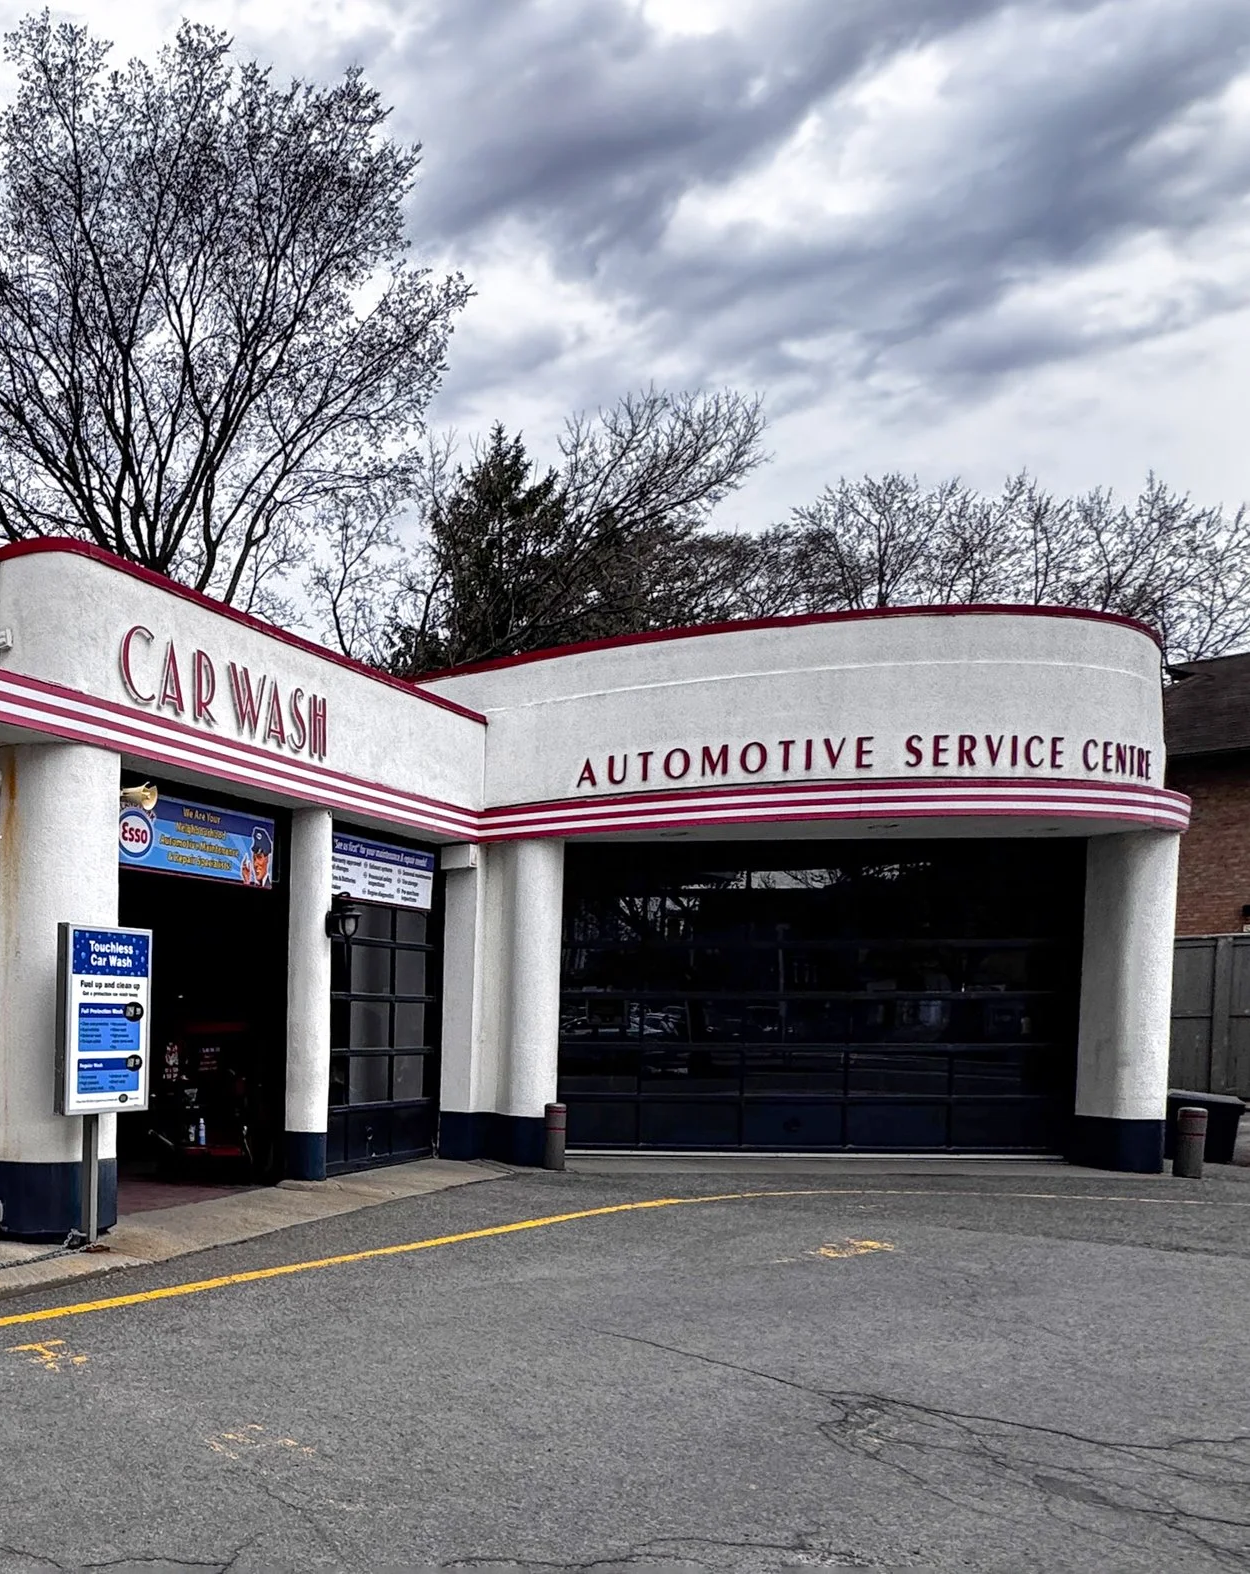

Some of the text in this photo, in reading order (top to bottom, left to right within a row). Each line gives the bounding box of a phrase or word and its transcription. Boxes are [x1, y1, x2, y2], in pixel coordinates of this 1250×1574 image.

[120, 625, 327, 761] CAR WASH
[576, 734, 1153, 788] AUTOMOTIVE SERVICE CENTRE
[182, 806, 221, 825] We Are Your
[121, 821, 148, 844] Esso
[89, 940, 134, 955] Touchless
[90, 953, 133, 968] Car Wash
[80, 980, 94, 988] Fuel
[133, 983, 141, 991] up
